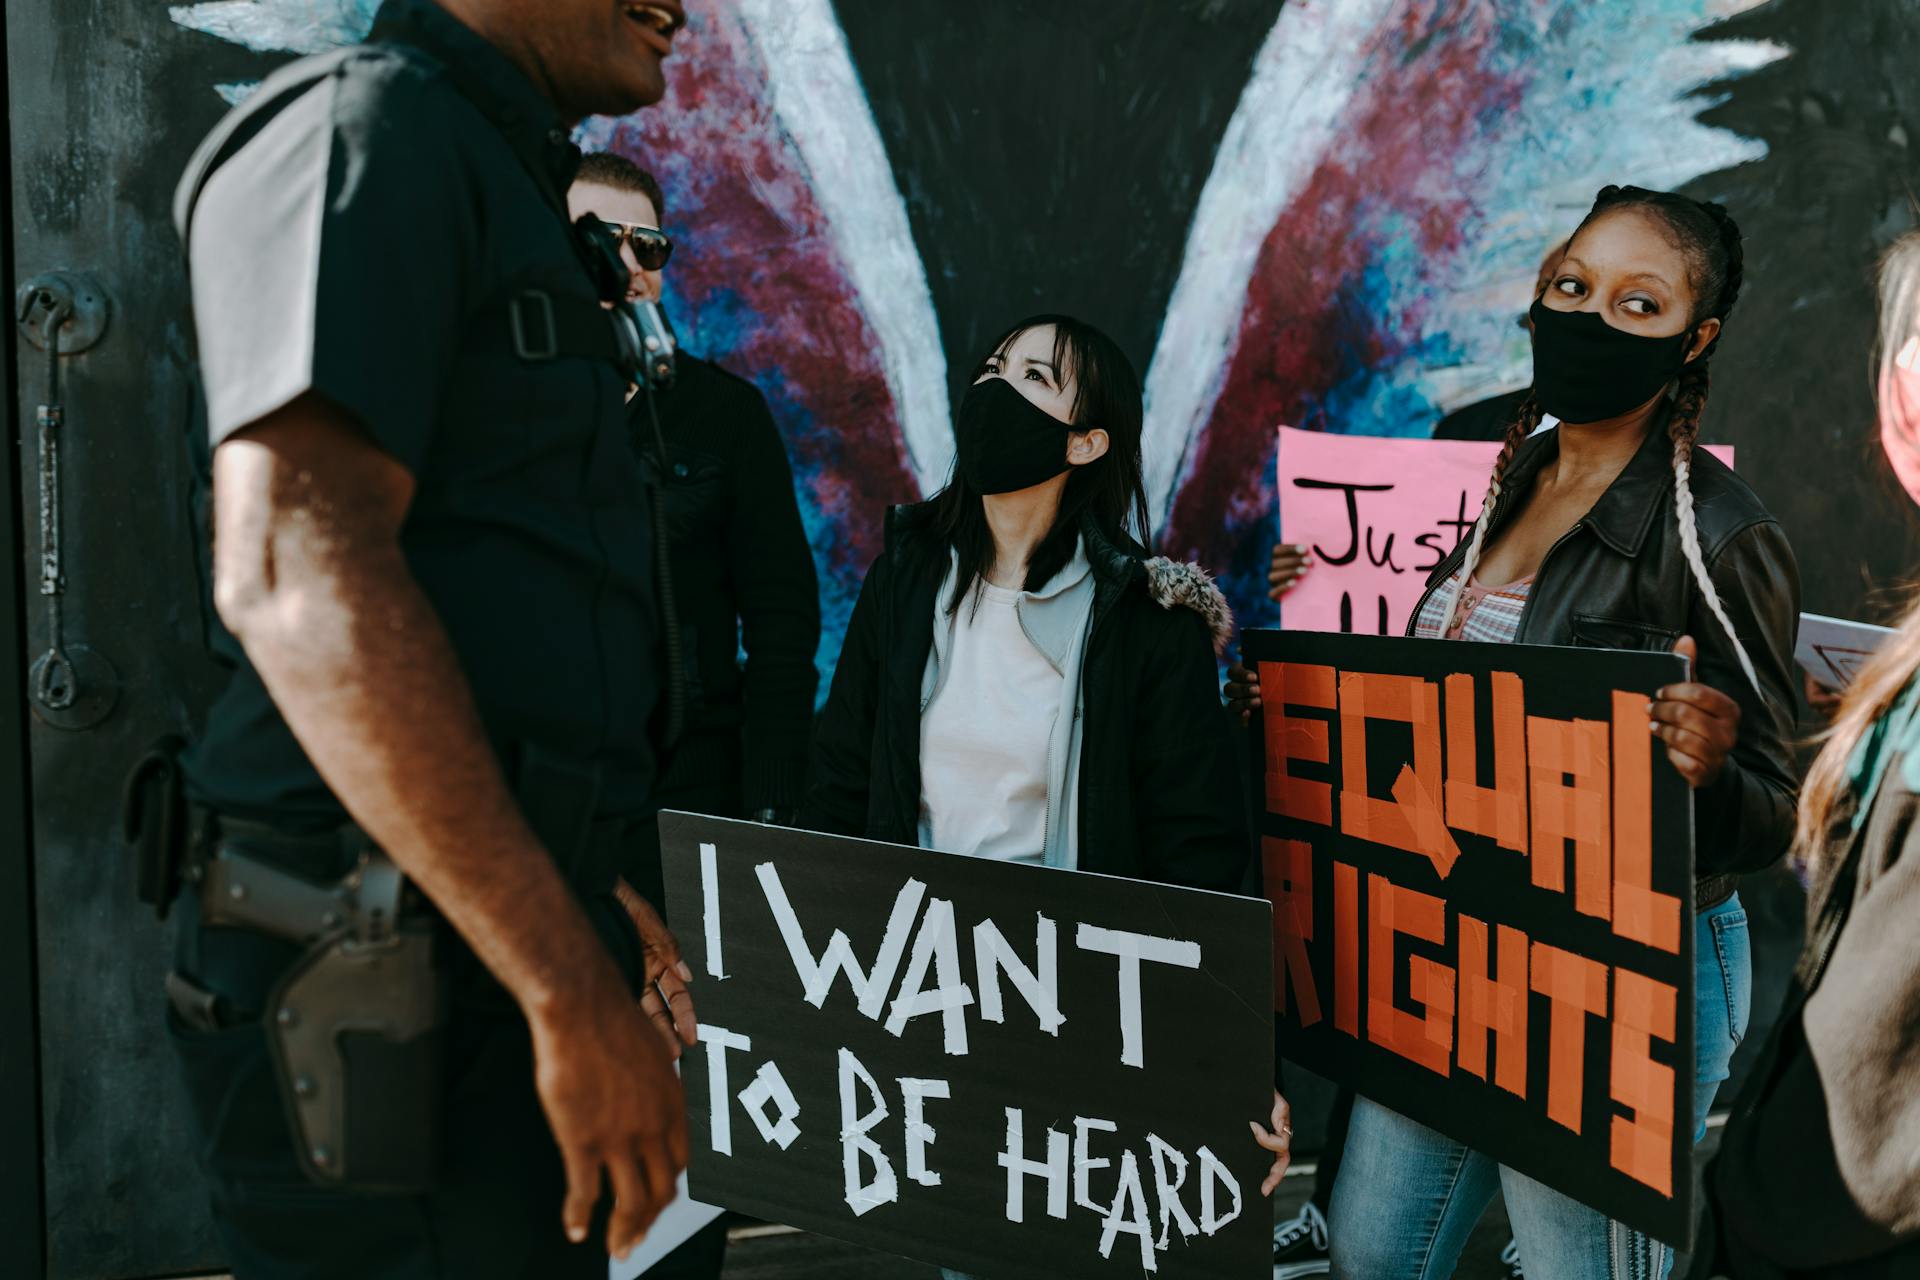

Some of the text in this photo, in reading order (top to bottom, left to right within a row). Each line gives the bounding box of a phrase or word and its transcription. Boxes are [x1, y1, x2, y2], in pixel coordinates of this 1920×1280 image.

[1258, 661, 1681, 954] EQUAL
[700, 843, 1201, 1069] I WANT
[1261, 834, 1678, 1199] RIGHTS
[696, 1024, 1243, 1272] TO BE HEARD
